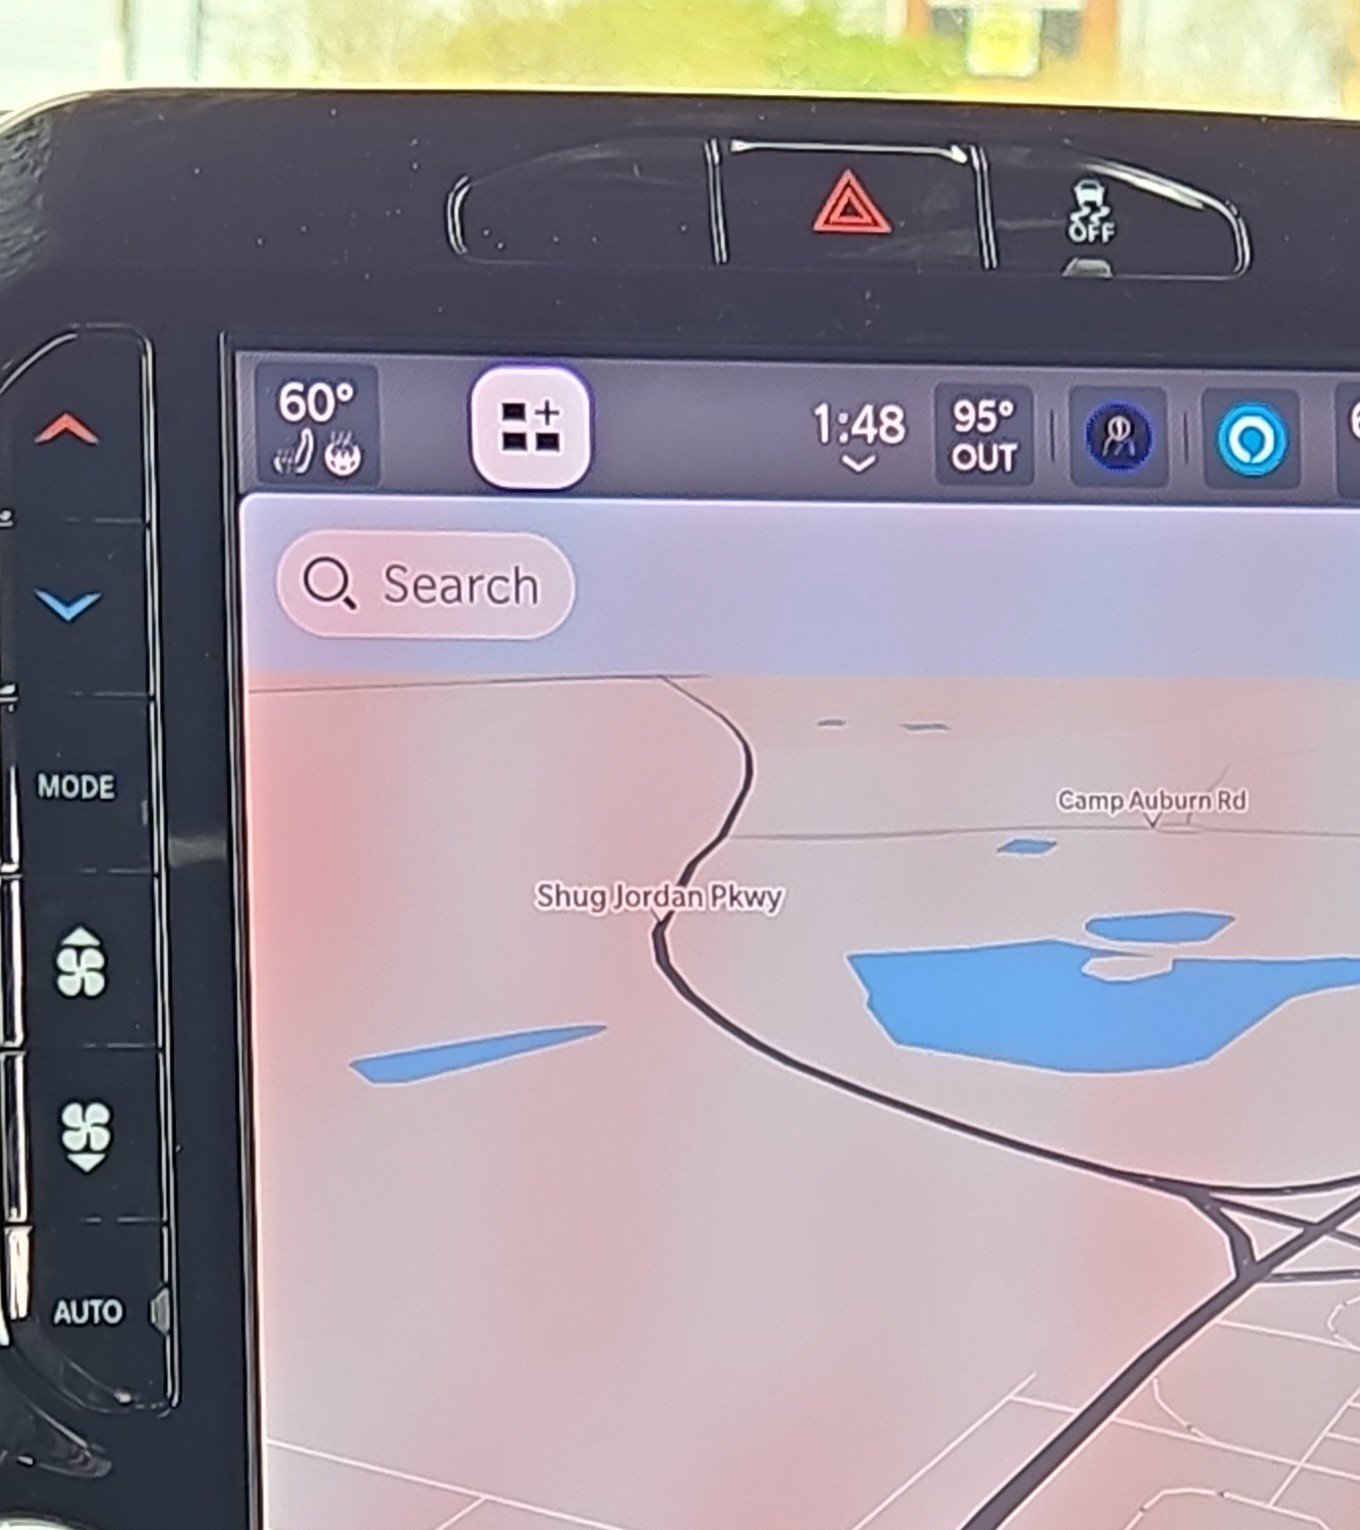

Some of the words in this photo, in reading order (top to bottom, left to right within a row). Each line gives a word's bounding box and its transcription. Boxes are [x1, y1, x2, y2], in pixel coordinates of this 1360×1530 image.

[1067, 223, 1115, 244] OFF
[278, 382, 354, 423] 60°
[952, 399, 1014, 432] 95°
[813, 402, 906, 446] 1:48
[951, 442, 1017, 474] OUT
[383, 563, 540, 606] Search
[38, 774, 115, 799] MODE
[1058, 789, 1124, 814] Camp
[1128, 789, 1212, 811] Auburn
[1217, 790, 1247, 811] Rd
[536, 883, 608, 912] Shug
[613, 883, 703, 911] Jordan
[710, 884, 783, 913] Pkwy
[53, 1299, 123, 1325] AUTO
